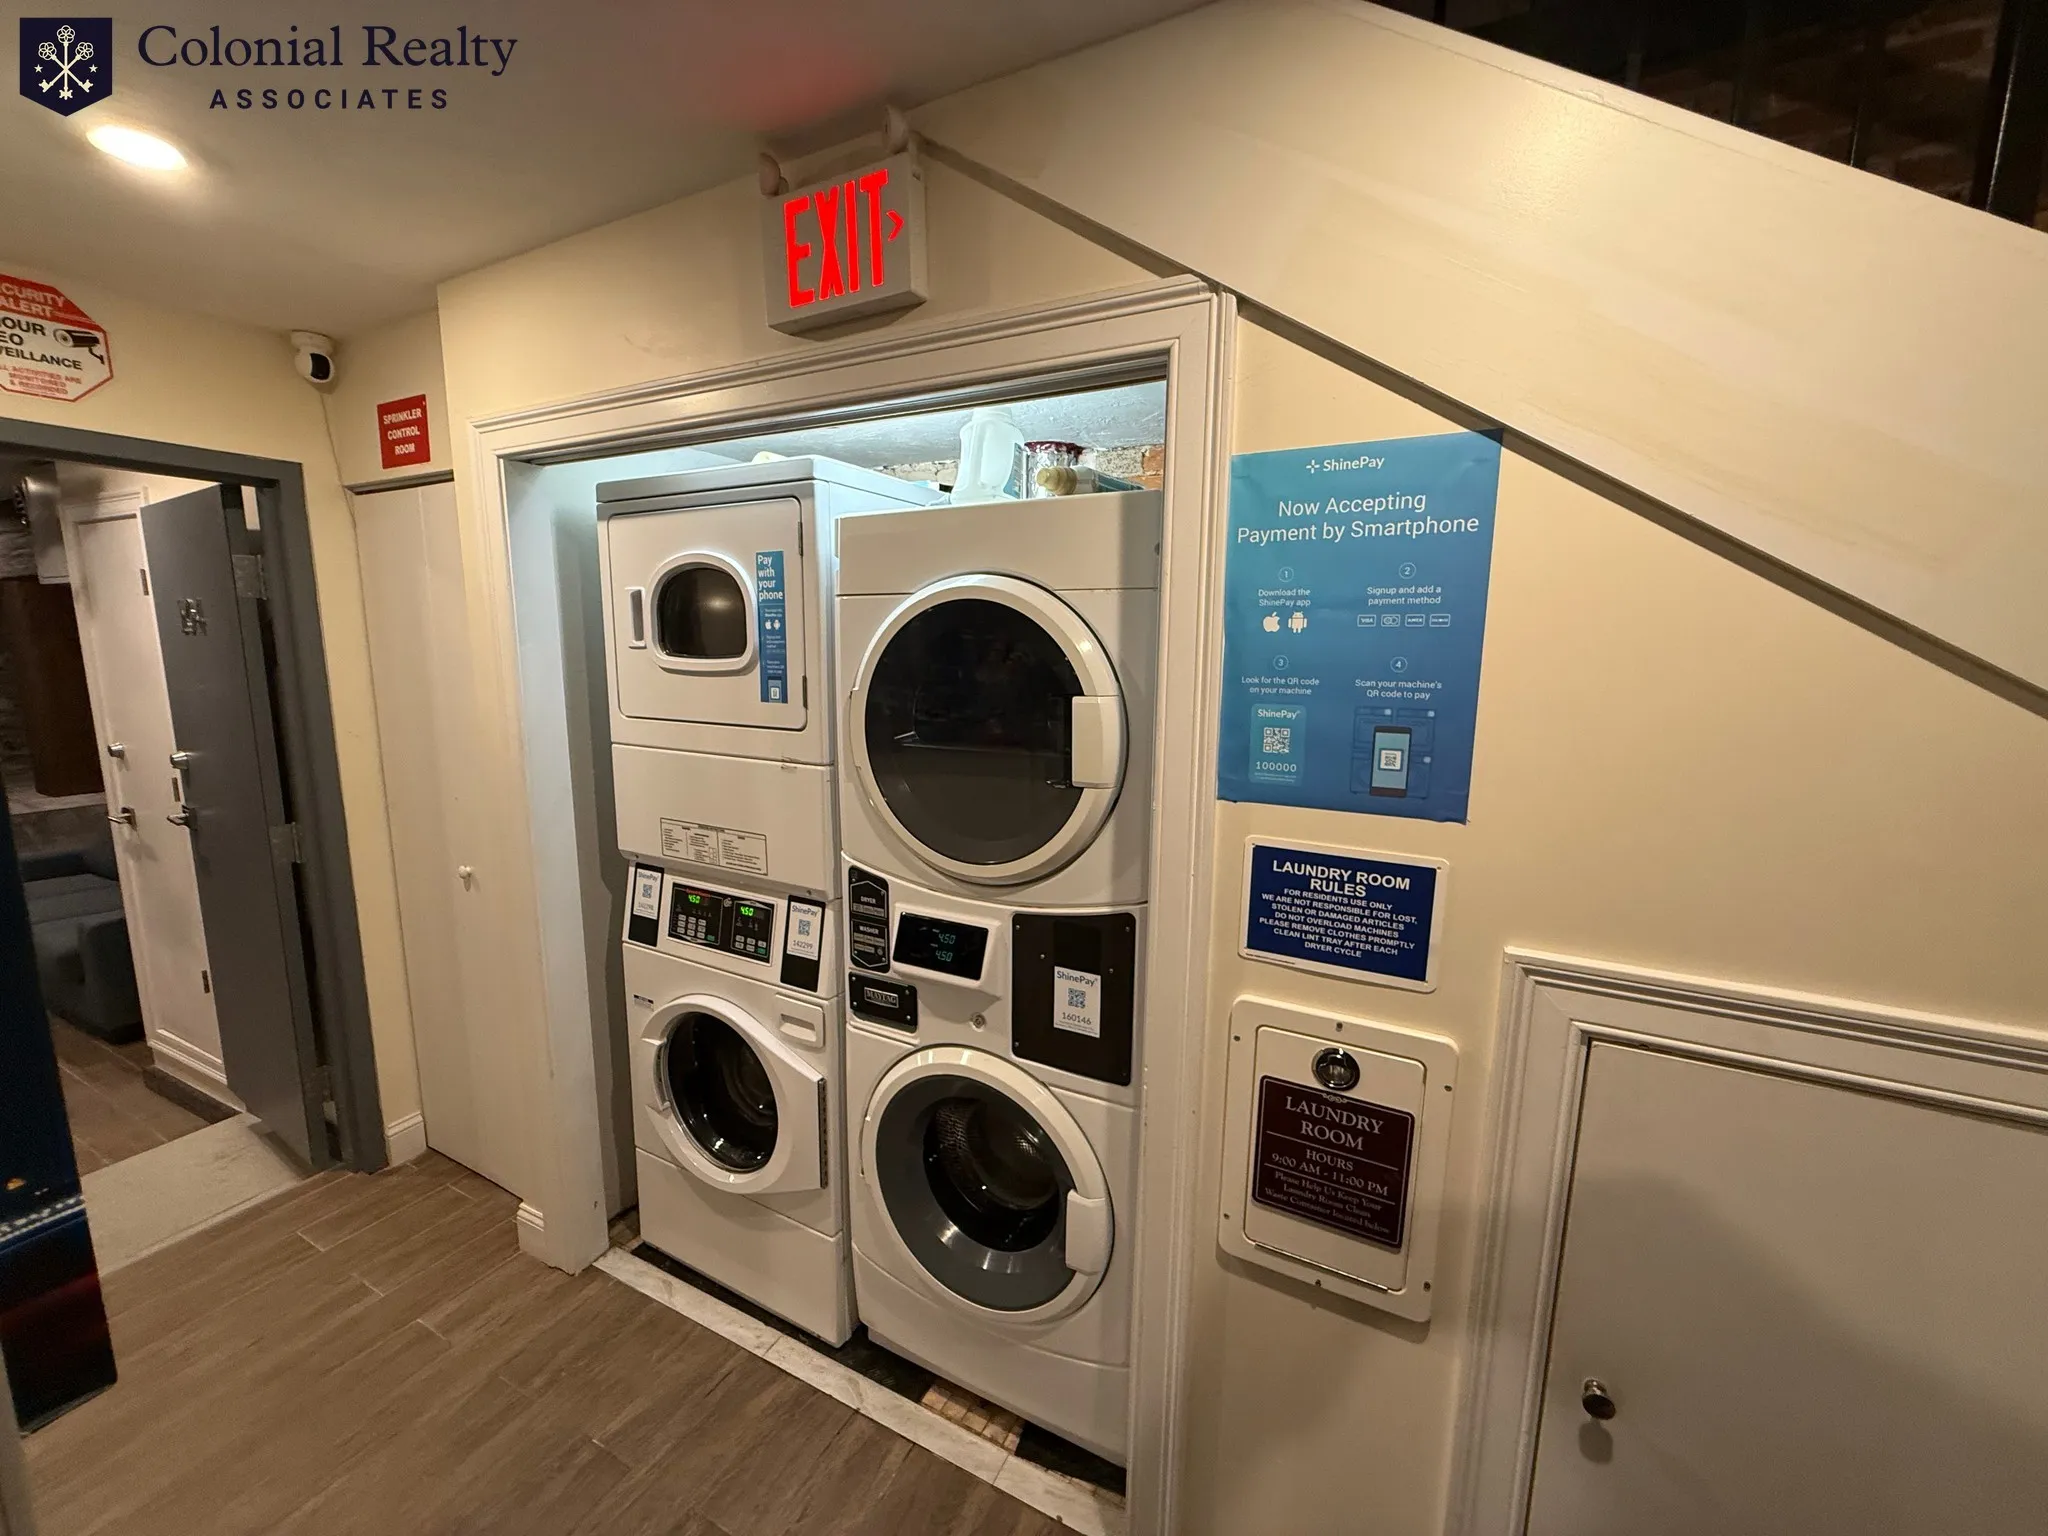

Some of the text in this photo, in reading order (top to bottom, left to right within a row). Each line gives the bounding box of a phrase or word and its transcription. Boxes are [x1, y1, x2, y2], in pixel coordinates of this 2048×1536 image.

[783, 168, 889, 309] EXIT
[0, 283, 64, 307] CURITY
[0, 316, 46, 336] OUR
[383, 408, 422, 424] SPRINKLER
[387, 425, 420, 440] CONTROL
[394, 443, 415, 455] ROOM
[1323, 456, 1385, 471] ShinePay
[1279, 491, 1426, 517] Now Accepting
[1237, 515, 1479, 546] Payment by Smartphone
[757, 554, 772, 567] Pay
[758, 567, 775, 577] with
[758, 580, 776, 590] your
[1258, 588, 1311, 597] Download the
[1367, 586, 1396, 595] Signup
[1398, 585, 1415, 594] and
[1417, 585, 1434, 594] add
[759, 590, 783, 602] phone
[1259, 598, 1311, 607] ShinePay app
[1368, 596, 1441, 606] payment method
[1241, 676, 1320, 685] Look for the QR code
[1355, 679, 1442, 689] Scan your machine's
[1260, 687, 1278, 695] your
[1279, 687, 1312, 695] machine
[1366, 689, 1379, 697] QR
[1380, 690, 1402, 698] code
[1414, 692, 1431, 700] pay
[1257, 708, 1297, 720] ShinePay
[1256, 761, 1297, 773] 100000
[1273, 860, 1411, 890] LAUNDRY ROOM
[1310, 878, 1367, 897] RULES
[1284, 888, 1393, 911] FOR RESIDENTS USE ONLY
[792, 905, 818, 917] ShinePay
[1261, 893, 1418, 925] WE ARE NOT RESPONSIBLE FOR LOST,
[1271, 902, 1405, 931] STOLEN OR DAMAGED ARTICLES
[1274, 911, 1399, 938] DO NOT OVERLOAD MACHINES
[1259, 917, 1415, 950] PLEASE REMOVE CLOTHES PROMPTLY
[1273, 928, 1398, 955] CLEAN LINT TRAY AFTER EACH
[1304, 941, 1362, 958] DRYER CYCLE
[1056, 970, 1095, 987] ShinePay
[866, 990, 896, 1003] MAYTAG
[1062, 1012, 1092, 1025] 160146
[1285, 1095, 1384, 1134] LAUNDRY
[1300, 1120, 1364, 1151] ROOM
[1306, 1149, 1354, 1171] HOURS
[1272, 1152, 1297, 1168] 9:00
[1299, 1161, 1320, 1175] AM
[1332, 1171, 1364, 1188] 11:00
[1367, 1181, 1388, 1196] PM
[1275, 1171, 1382, 1211] Please Help Us Keep Your
[1283, 1183, 1371, 1218] Laundry Room Clean
[1265, 1187, 1288, 1200] Waste
[1364, 1220, 1390, 1233] below
